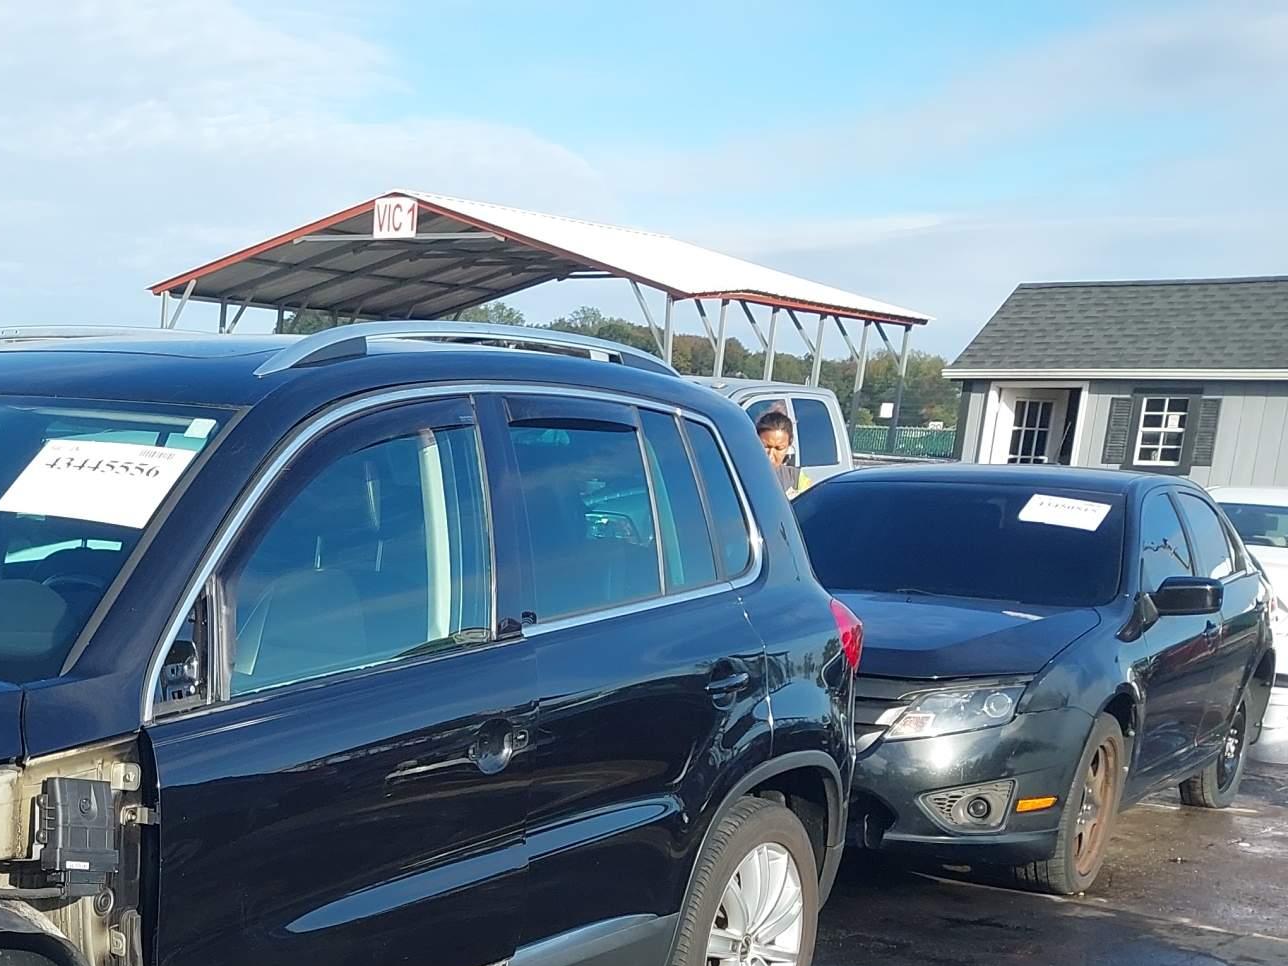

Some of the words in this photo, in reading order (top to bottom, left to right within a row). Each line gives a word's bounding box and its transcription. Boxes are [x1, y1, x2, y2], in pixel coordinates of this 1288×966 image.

[376, 203, 403, 233] VIC
[407, 202, 416, 232] 1
[45, 456, 161, 478] 43445556
